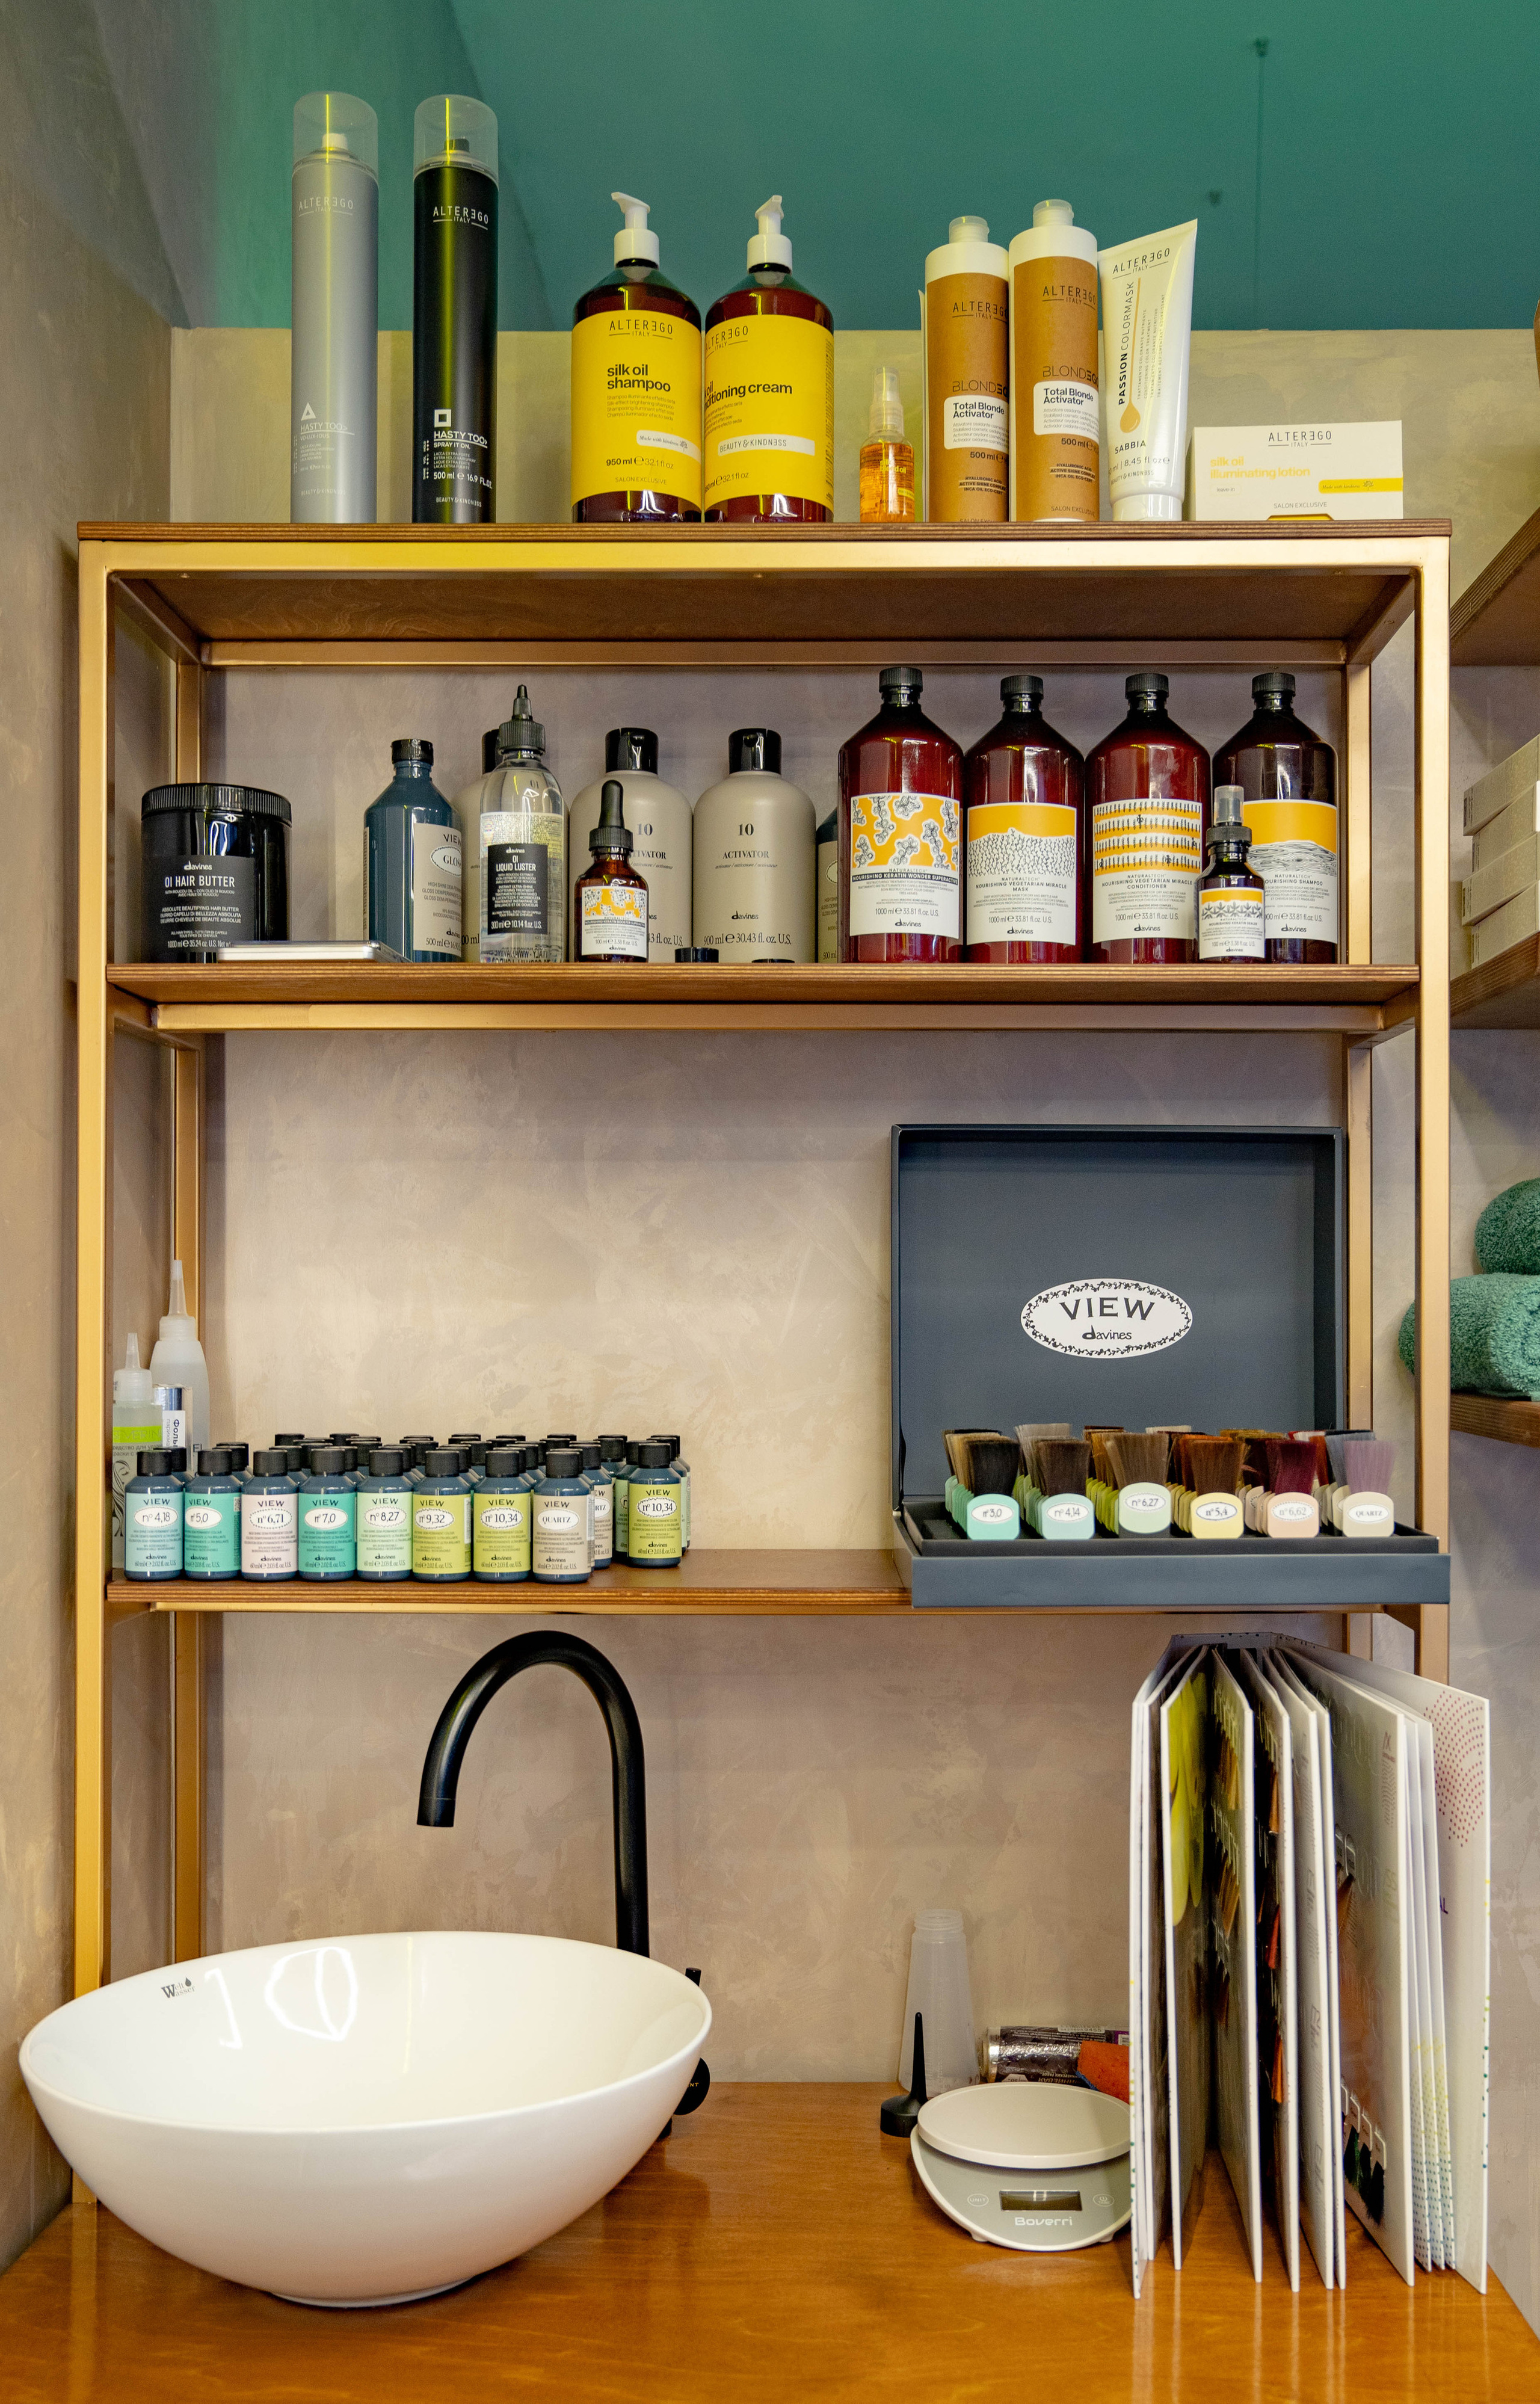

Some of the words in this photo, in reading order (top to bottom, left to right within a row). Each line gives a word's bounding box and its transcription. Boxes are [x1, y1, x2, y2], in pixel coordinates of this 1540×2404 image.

[1133, 264, 1148, 273] ITALY
[715, 342, 727, 351] ITALY
[607, 364, 630, 377] silk
[632, 364, 648, 376] oil
[607, 378, 671, 392] shampoo
[748, 383, 793, 395] cream
[1044, 387, 1068, 396] Total
[1069, 388, 1094, 402] Blonde
[1044, 396, 1083, 406] Activator
[953, 402, 976, 410] Total
[978, 402, 1004, 415] Blonde
[953, 411, 994, 419] Activator
[301, 422, 322, 431] HASTY
[434, 431, 466, 439] HASTY
[1061, 437, 1076, 446] 500
[1077, 439, 1085, 448] ml
[1115, 440, 1146, 454] SABBIA
[1210, 457, 1228, 467] silk
[1231, 457, 1244, 466] oil
[1210, 467, 1276, 479] illuminating
[1278, 467, 1310, 476] lotion
[637, 824, 653, 836] 10
[739, 824, 754, 836] 10
[723, 850, 769, 860] ACTIVATOR
[184, 860, 212, 871] davines
[496, 863, 513, 872] LIQUID
[176, 875, 195, 887] HAIR
[199, 875, 235, 887] BUTTER
[853, 873, 882, 881] NOURISHING
[932, 875, 958, 885] SUPERACTIVE
[1102, 879, 1133, 887] NOURISHING
[732, 910, 759, 920] davines
[895, 918, 921, 927] davines
[1134, 923, 1160, 931] davines
[1007, 926, 1033, 934] davines
[1281, 924, 1307, 932] davines
[427, 938, 436, 946] 500
[704, 935, 713, 946] 900
[715, 933, 724, 945] ml
[736, 933, 756, 943] 30.43
[1059, 1296, 1155, 1321] VIEW
[1082, 1325, 1132, 1340] davines
[652, 1503, 673, 1512] 10,34
[1142, 1498, 1159, 1507] 6,27
[381, 1511, 399, 1521] 8,27
[1065, 1508, 1080, 1517] 4,14
[1215, 1508, 1228, 1517] 5,4
[1289, 1507, 1306, 1516] 6,62
[155, 1512, 170, 1523] 4,18
[267, 1514, 283, 1524] 6,71
[426, 1514, 445, 1524] 9,32
[495, 1512, 517, 1523] 10,34
[542, 1516, 571, 1524] QUARTZ
[1015, 2216, 1072, 2226] Boverri
